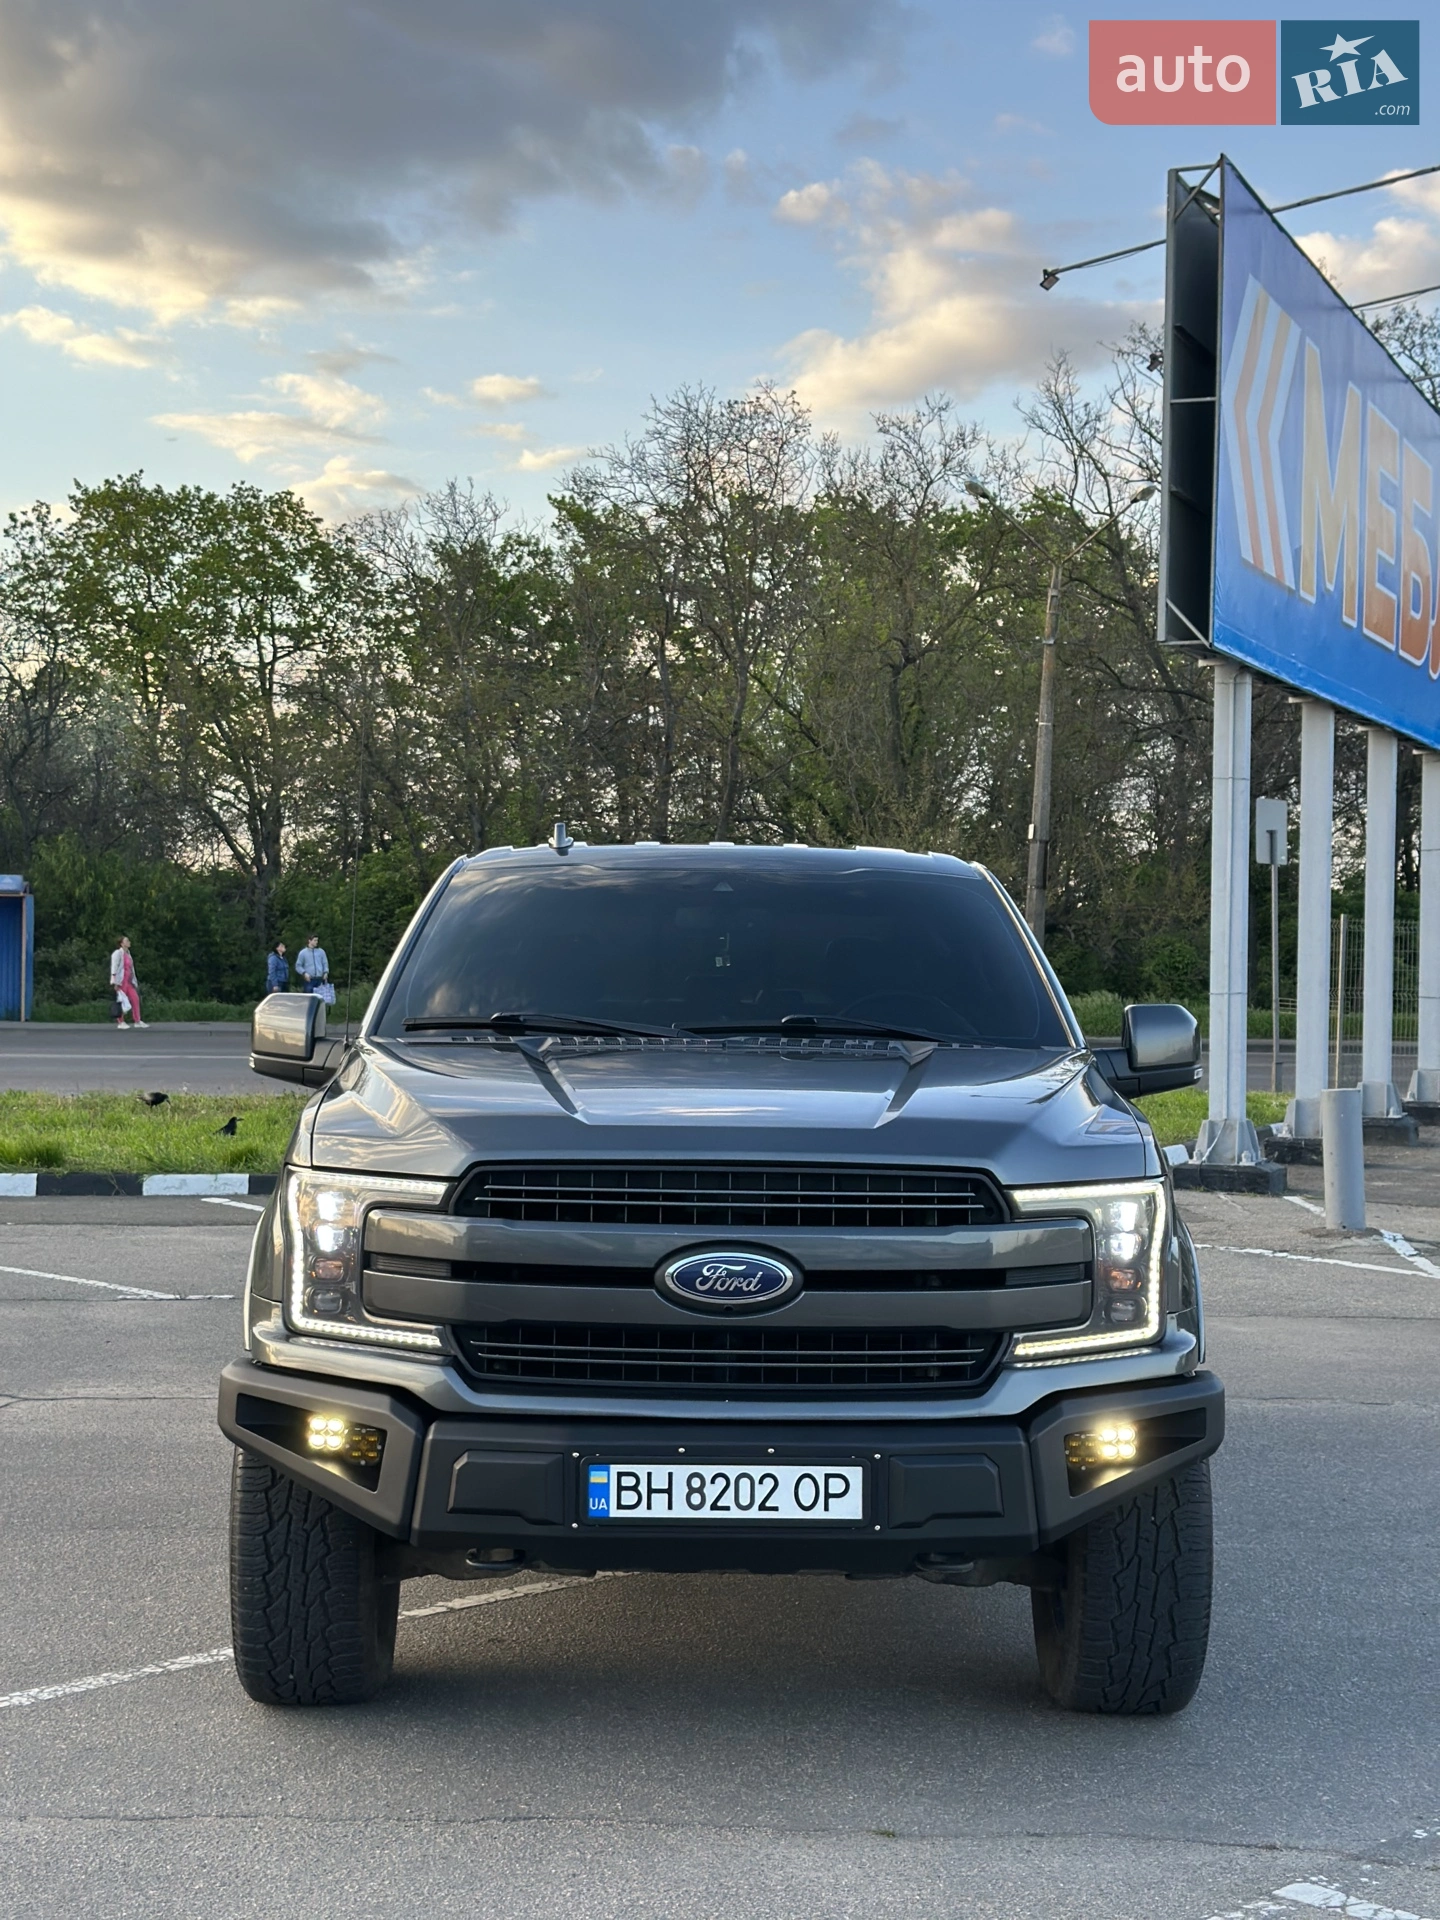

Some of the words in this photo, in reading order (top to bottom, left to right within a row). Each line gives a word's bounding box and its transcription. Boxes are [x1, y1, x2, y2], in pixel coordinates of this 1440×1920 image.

[1299, 336, 1440, 681] МЕБ
[695, 1263, 764, 1292] Ford
[589, 1497, 608, 1511] UA
[616, 1471, 674, 1511] BH
[685, 1471, 780, 1512] 8202
